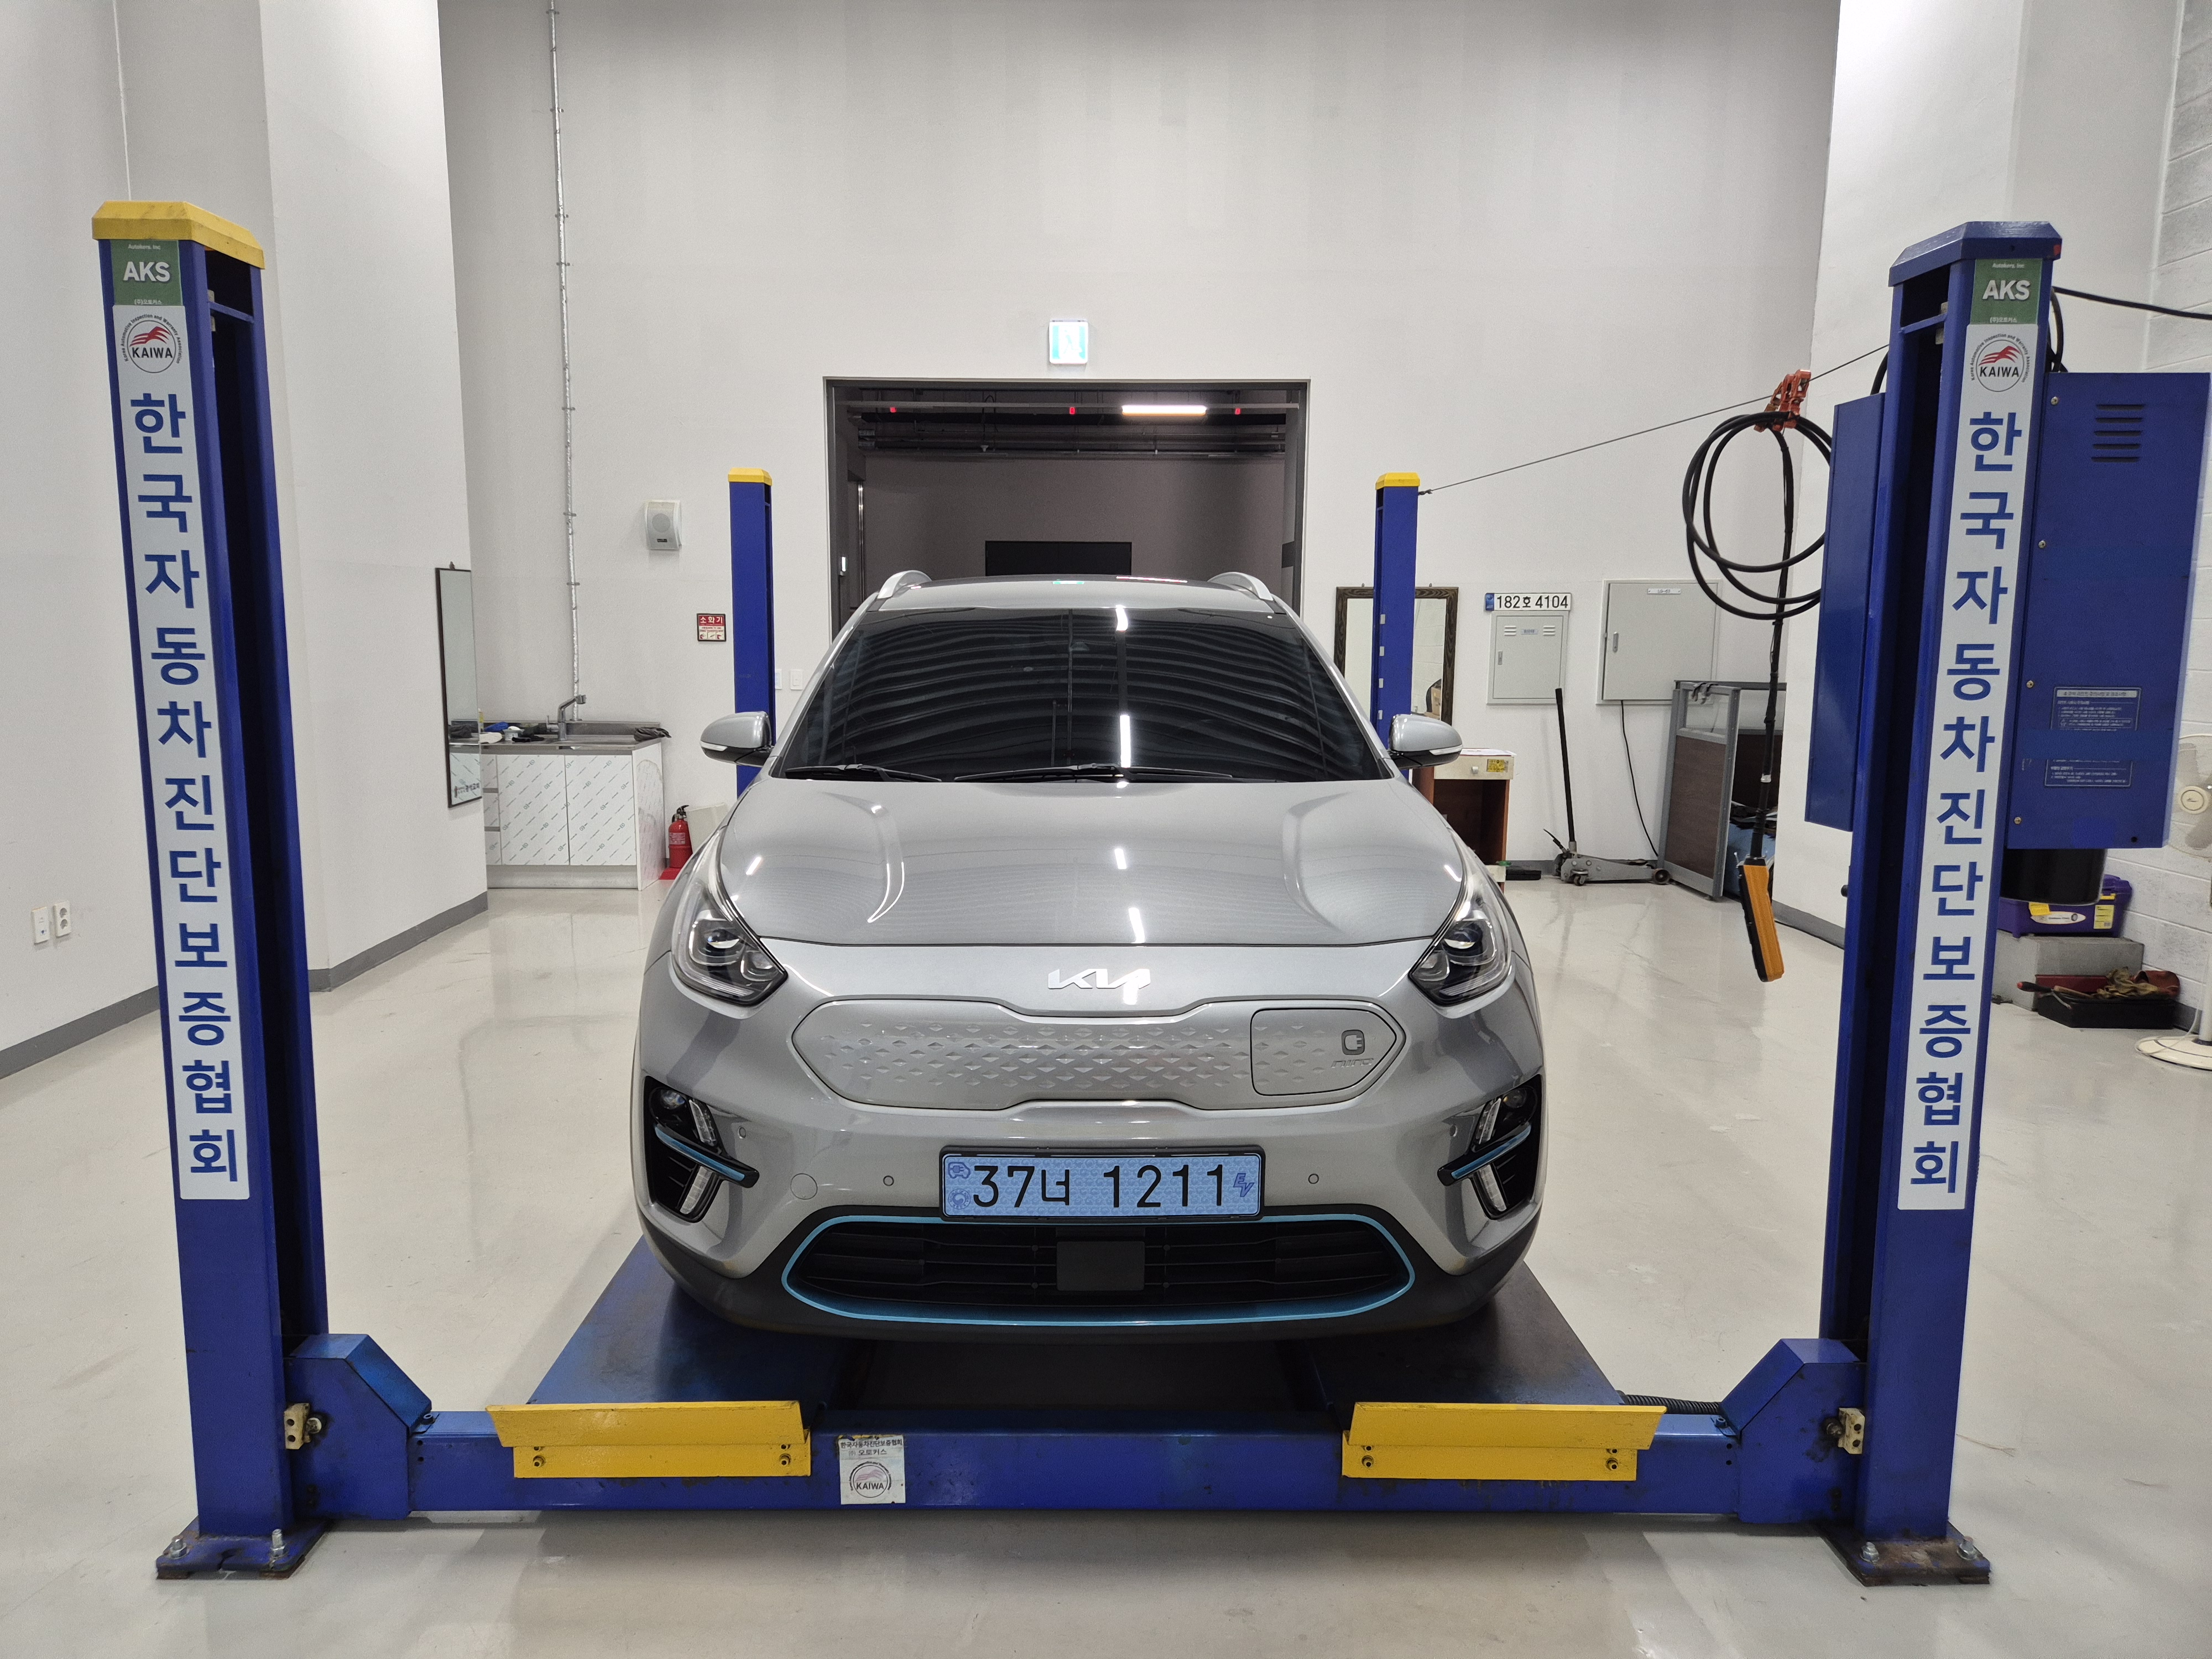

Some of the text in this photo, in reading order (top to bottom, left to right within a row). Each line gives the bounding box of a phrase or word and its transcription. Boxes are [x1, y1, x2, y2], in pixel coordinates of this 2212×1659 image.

[123, 261, 170, 282] AKS
[1982, 280, 2030, 300] AKS
[131, 314, 153, 324] Inspection
[163, 318, 178, 335] Warranty
[132, 347, 173, 358] KAIWA
[1984, 333, 2007, 343] Inspection
[2016, 337, 2028, 355] Warranty
[1980, 367, 2020, 377] KAIWA
[1497, 595, 1568, 608] 182호 4104
[131, 393, 238, 1182] 한국자동차진단보증협회
[1910, 411, 2022, 1193] 한국자동차진단보증협회
[1331, 1058, 1374, 1068] niro
[973, 1165, 1070, 1208] 37너
[1104, 1164, 1223, 1208] 1211
[1233, 1173, 1255, 1197] EV
